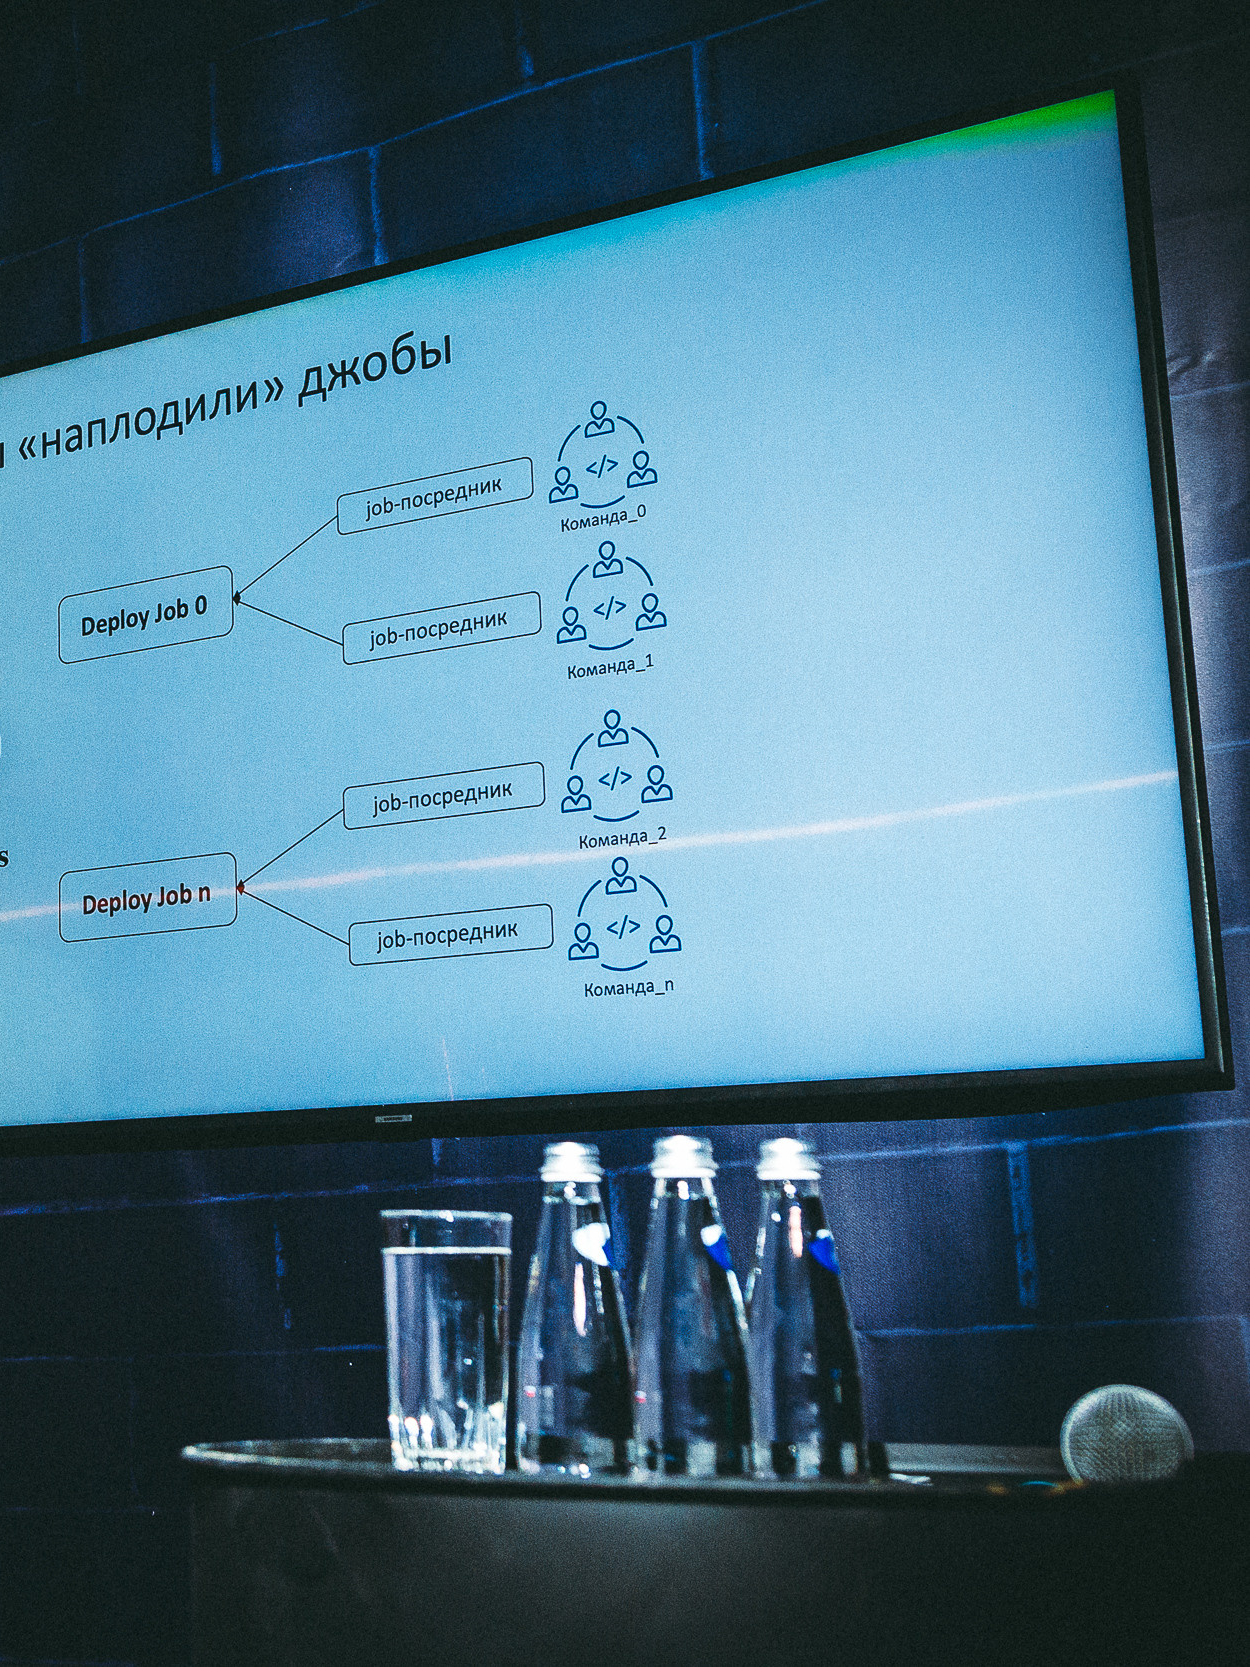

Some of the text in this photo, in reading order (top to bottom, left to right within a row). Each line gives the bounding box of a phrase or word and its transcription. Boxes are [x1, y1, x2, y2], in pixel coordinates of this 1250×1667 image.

[18, 377, 284, 461] «наплодили»
[298, 331, 452, 407] джобы
[365, 478, 503, 522] job-посредник
[560, 503, 647, 533] Команда_0
[82, 594, 208, 637] Deploy Job 0
[369, 610, 508, 651] job-посредник
[567, 653, 654, 680] Команда_1
[372, 782, 513, 818] job-посредник
[578, 825, 667, 850] Команда_2
[82, 882, 211, 918] Deploy Job n
[376, 922, 519, 954] job-посредник
[584, 979, 674, 998] Команда_n
